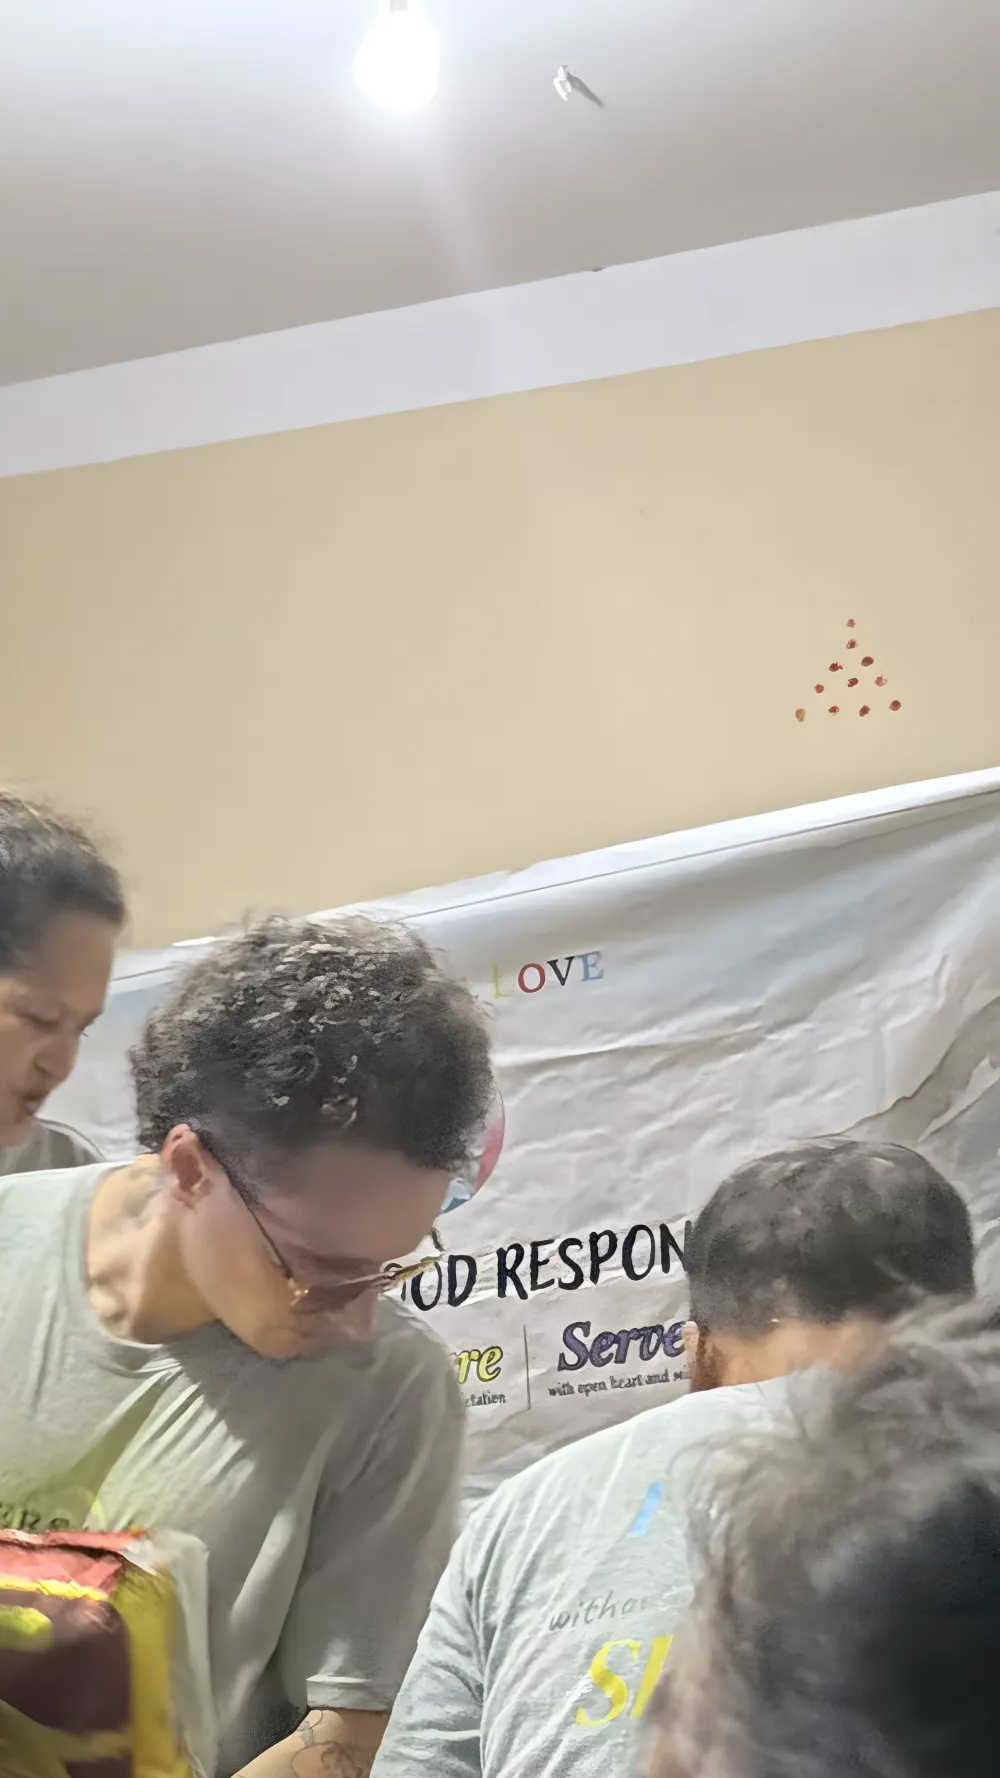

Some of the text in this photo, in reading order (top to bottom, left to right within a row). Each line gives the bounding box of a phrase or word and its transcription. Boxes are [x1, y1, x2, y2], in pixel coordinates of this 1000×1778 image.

[492, 950, 604, 999] LOVE
[496, 1219, 692, 1301] RESPON
[457, 1345, 503, 1385] re
[557, 1320, 688, 1372] Serve
